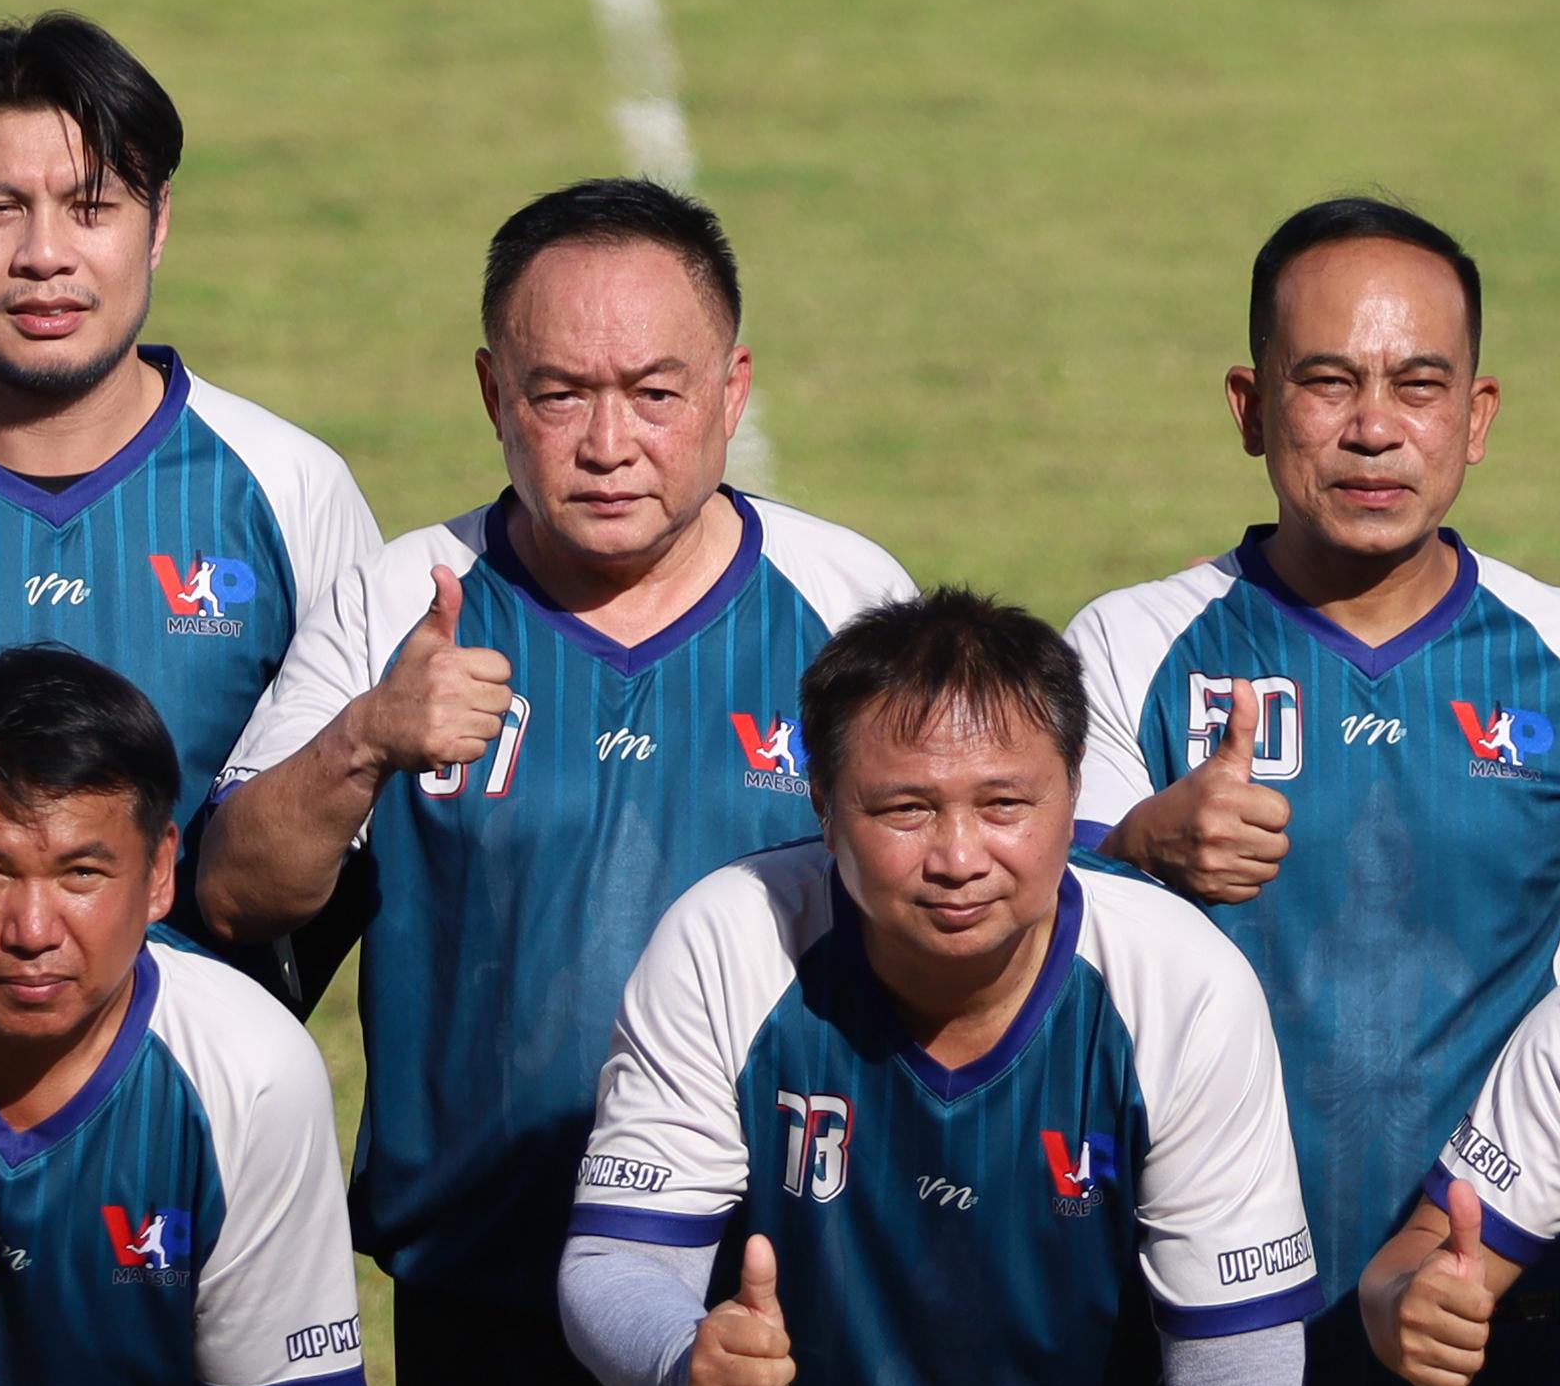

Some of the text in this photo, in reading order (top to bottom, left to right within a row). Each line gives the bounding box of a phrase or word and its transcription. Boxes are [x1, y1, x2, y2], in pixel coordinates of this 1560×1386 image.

[166, 616, 243, 638] MAESOT
[1186, 671, 1304, 781] 50
[1217, 1244, 1262, 1286] VIP
[286, 1324, 329, 1363] VIP
